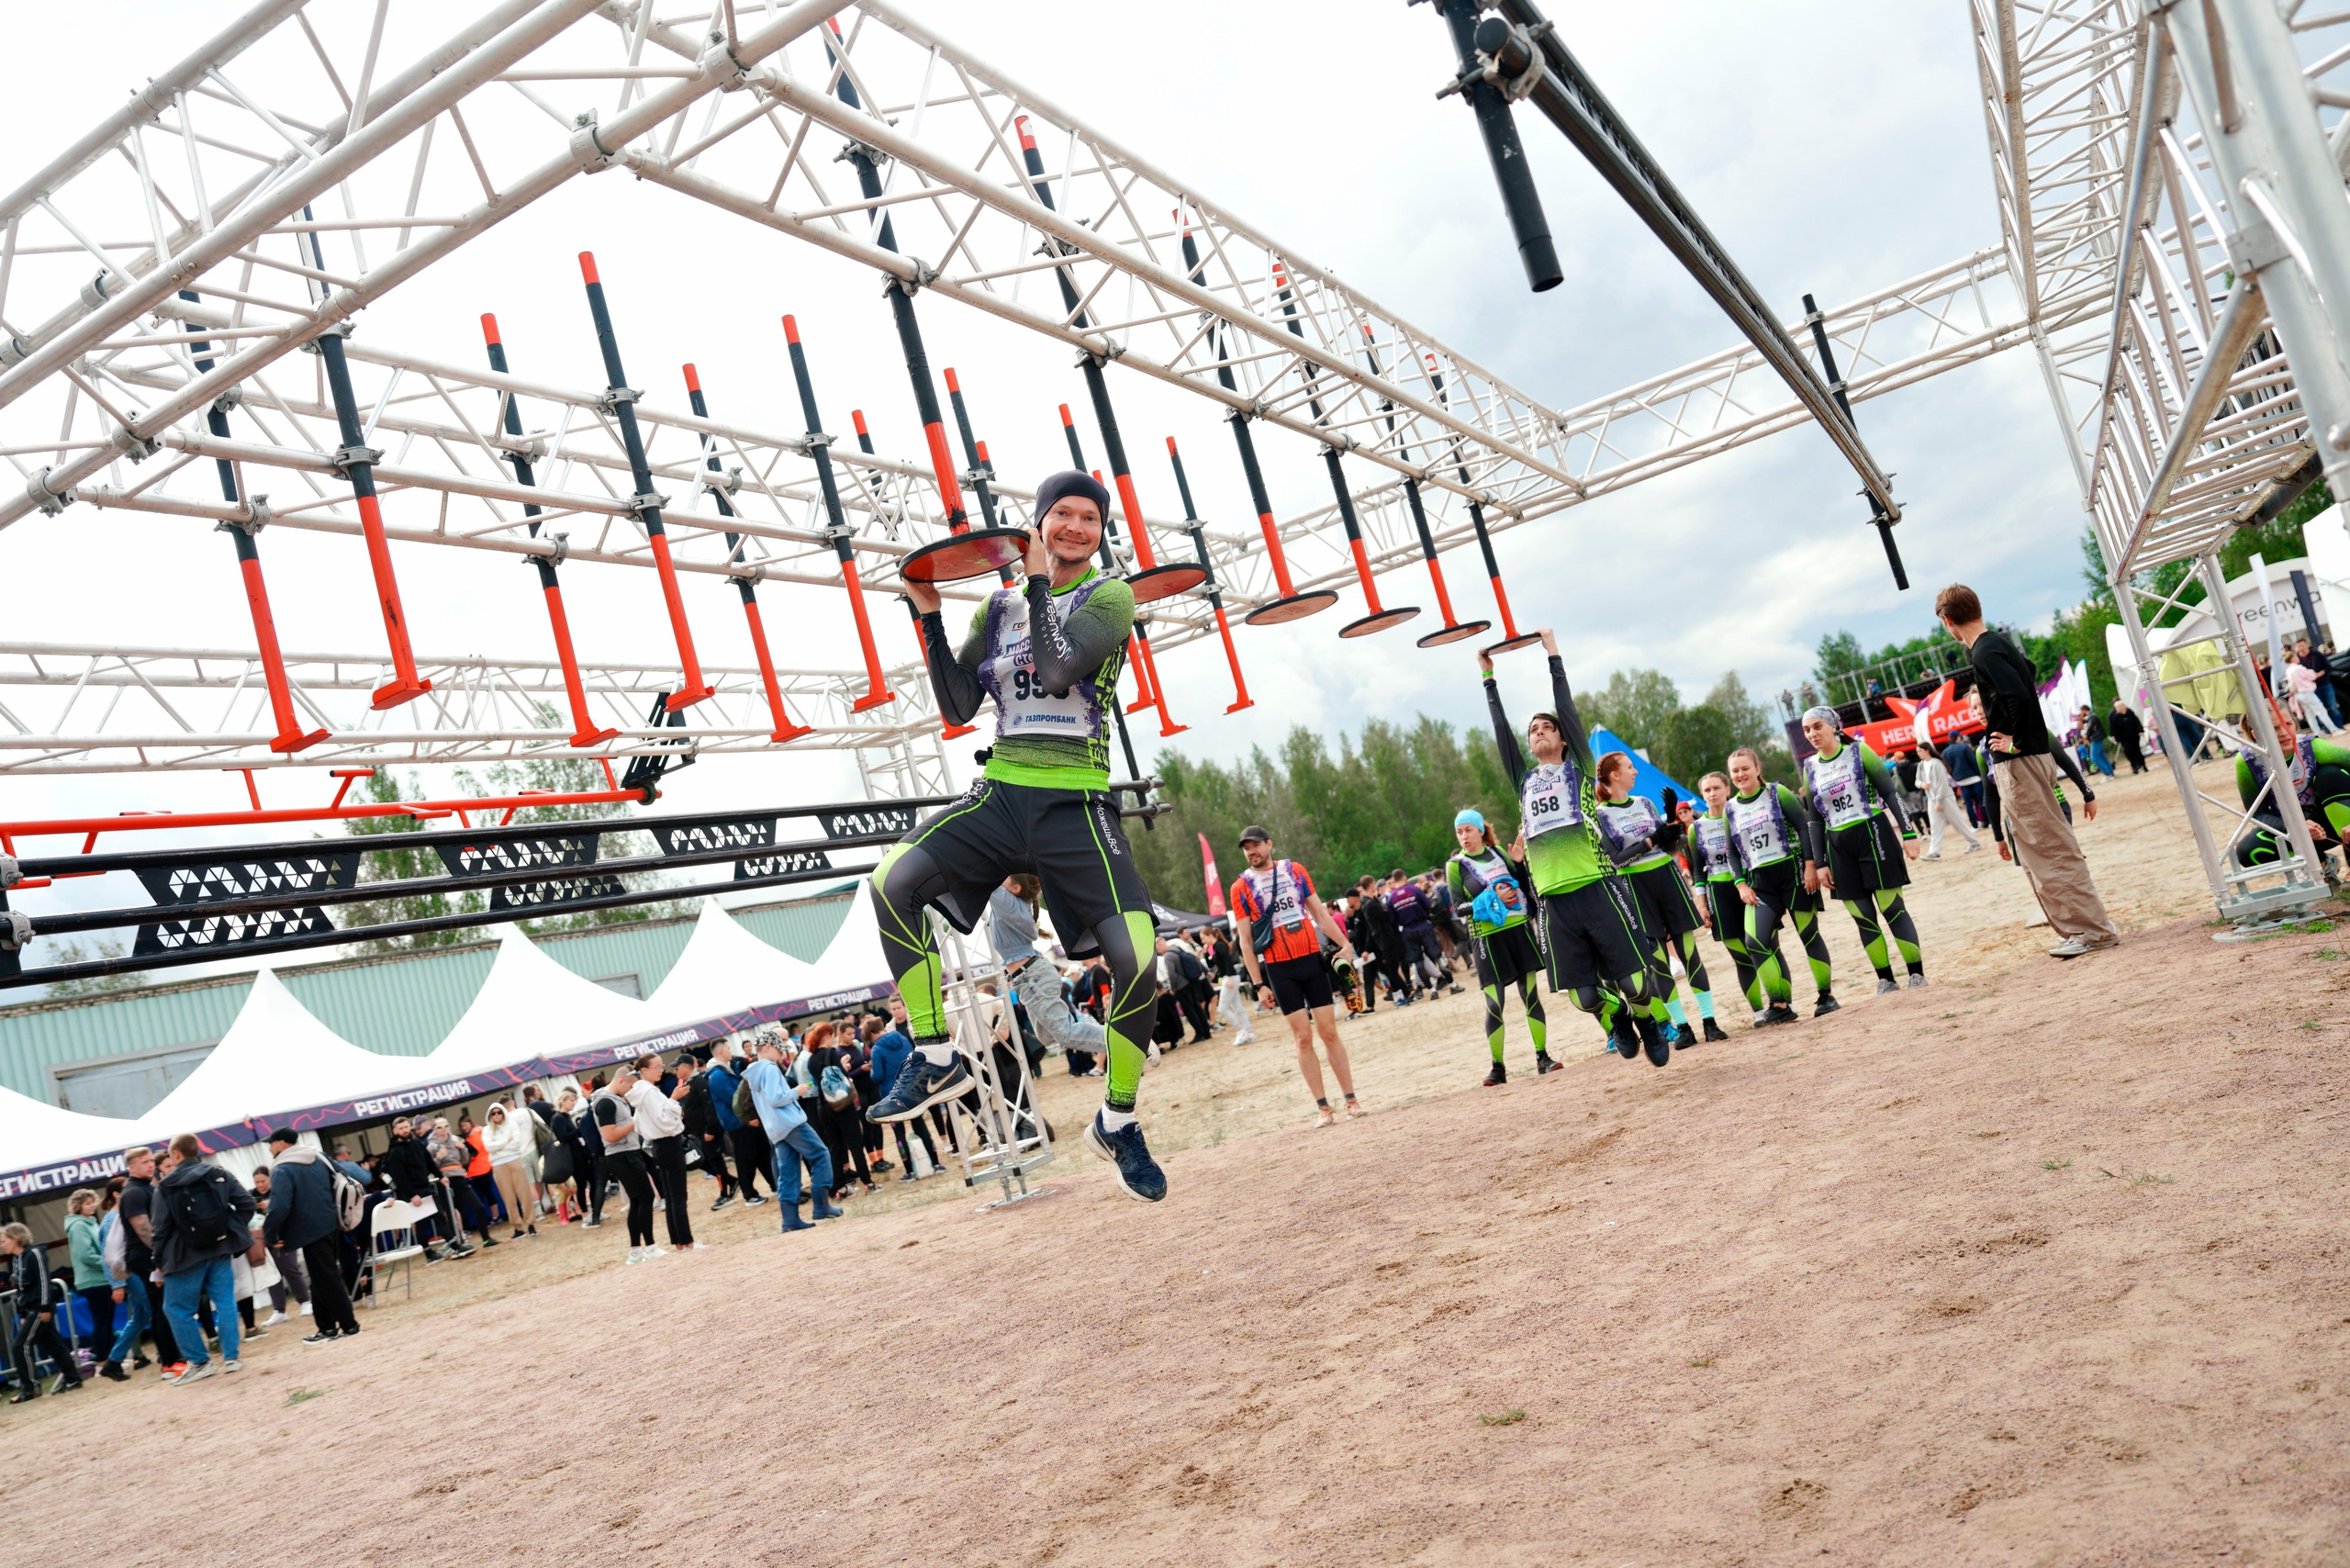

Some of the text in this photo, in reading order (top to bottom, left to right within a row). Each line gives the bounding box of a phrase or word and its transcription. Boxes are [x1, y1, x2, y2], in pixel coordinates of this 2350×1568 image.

[2237, 590, 2322, 622] reenwa
[1005, 638, 1032, 655] МАСС
[1013, 669, 1069, 700] 99
[1025, 714, 1077, 724] ГАЗПРОМБАНК
[1881, 725, 1917, 745] HER
[1531, 796, 1560, 816] 958
[1832, 794, 1853, 812] 962
[1750, 832, 1769, 852] 957
[808, 988, 872, 1011] РЕГИСТРАЦИЯ
[613, 1029, 699, 1059] РЕГИСТРАЦИЯ
[353, 1080, 471, 1117] РЕГИСТРАЦИЯ
[0, 1154, 129, 1198] ГИСТРАЦИ
